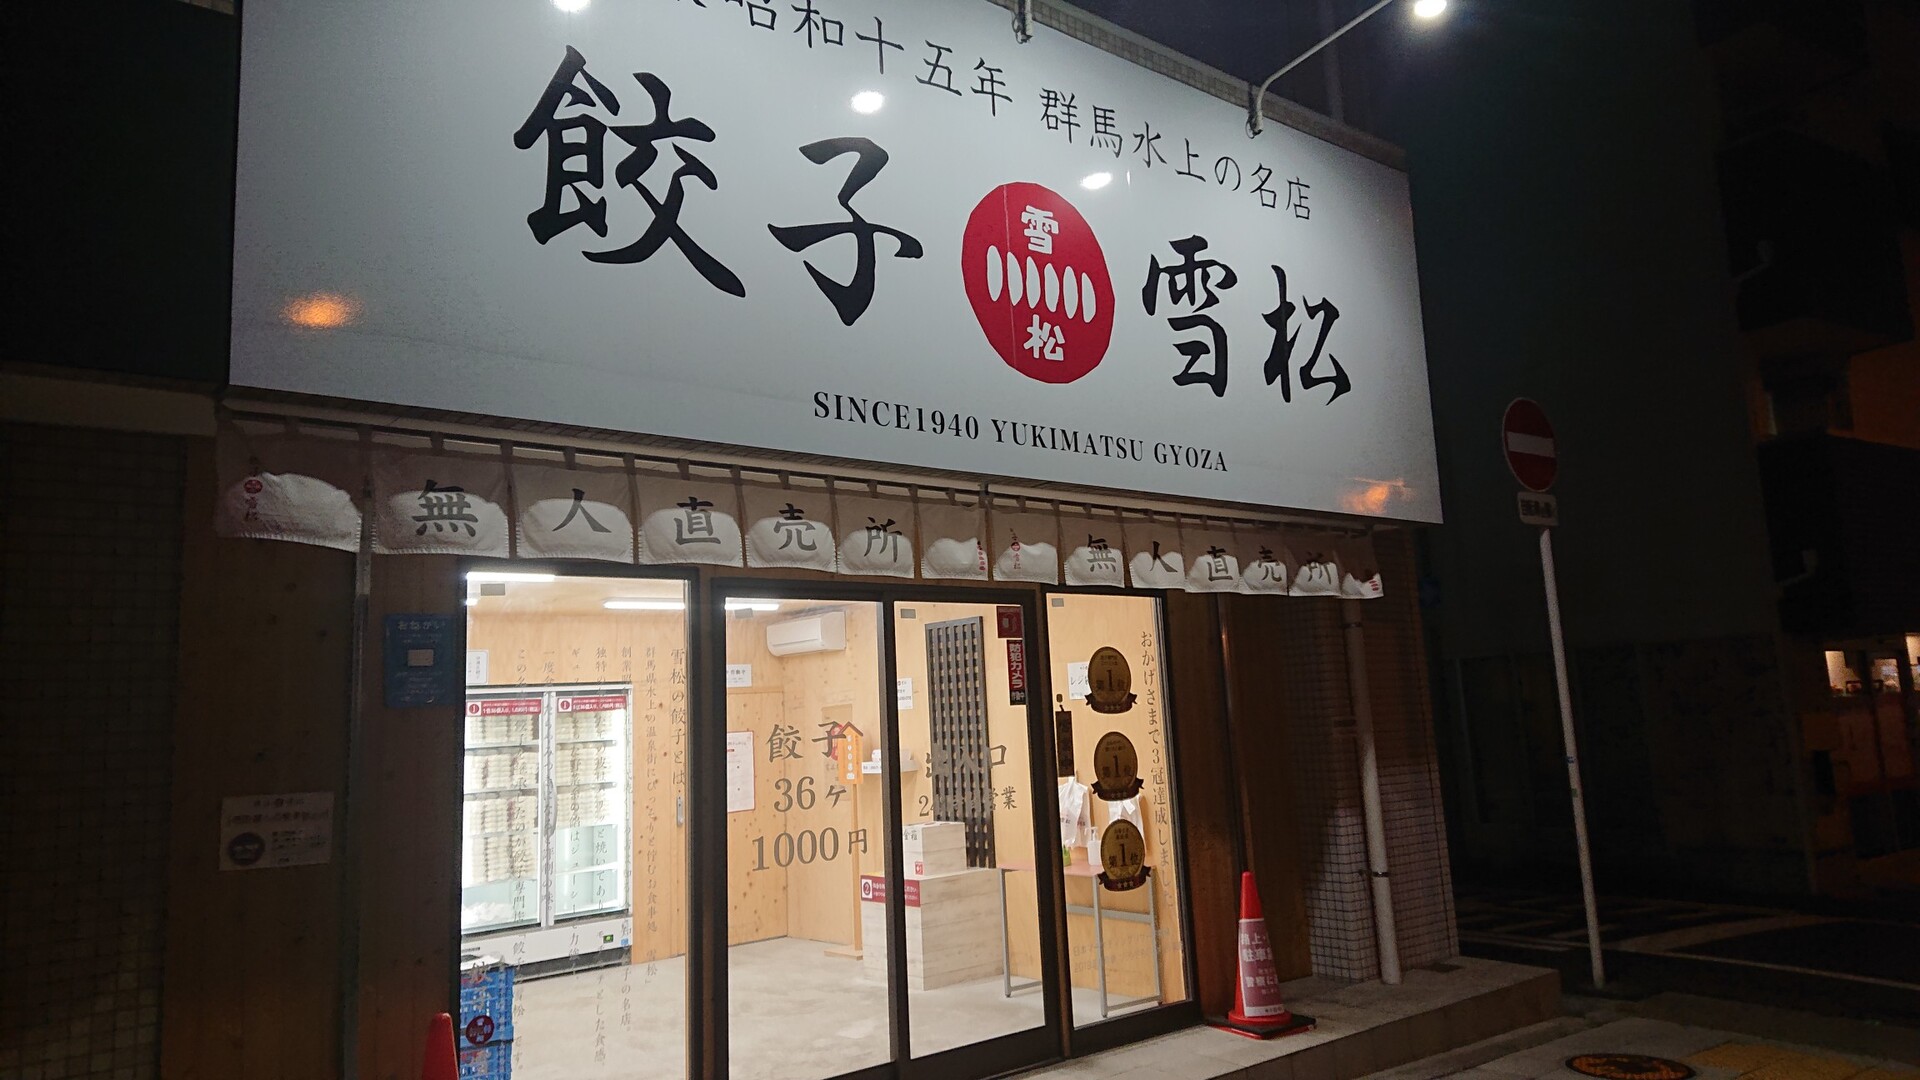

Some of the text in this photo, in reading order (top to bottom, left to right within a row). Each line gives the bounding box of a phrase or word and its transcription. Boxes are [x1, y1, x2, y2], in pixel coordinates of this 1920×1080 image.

[692, 0, 1313, 221] 昭和十五年 群馬水上の名店
[513, 44, 1352, 406] 餃子 雪松
[1021, 204, 1060, 255] 雪
[1023, 313, 1066, 362] 松
[813, 390, 1228, 473] SINCE1940 YUKIMATSU GYOZA
[411, 479, 903, 565] 無人直売所
[1086, 533, 1336, 586] 無人直売所
[1009, 643, 1024, 689] 防犯カメラ
[765, 720, 847, 763] 餃子
[918, 785, 1018, 818] 2時間営業
[751, 827, 869, 873] 1000円
